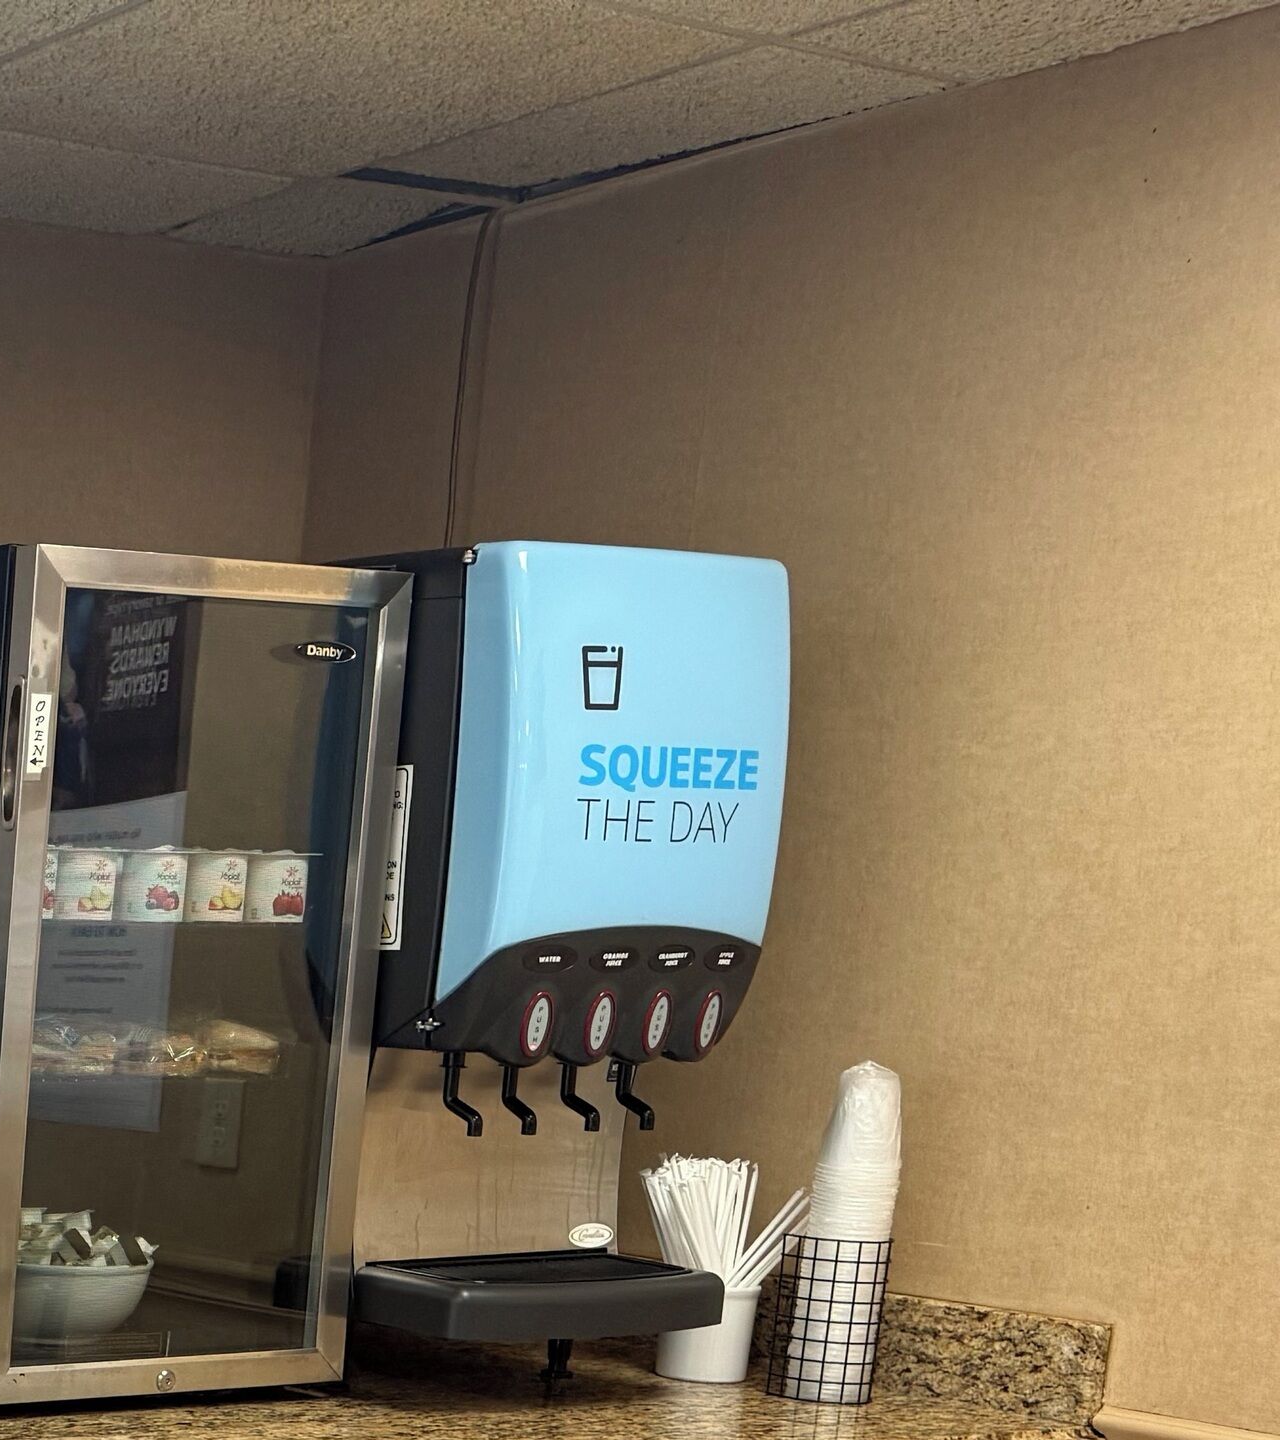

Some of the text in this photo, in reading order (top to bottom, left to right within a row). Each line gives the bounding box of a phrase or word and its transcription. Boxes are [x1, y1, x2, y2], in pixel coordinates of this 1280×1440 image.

[306, 644, 344, 660] Danby
[32, 700, 46, 756] OPEN
[577, 743, 760, 792] SQUEEZE
[577, 797, 740, 844] THE DAY
[539, 956, 562, 964] WATER
